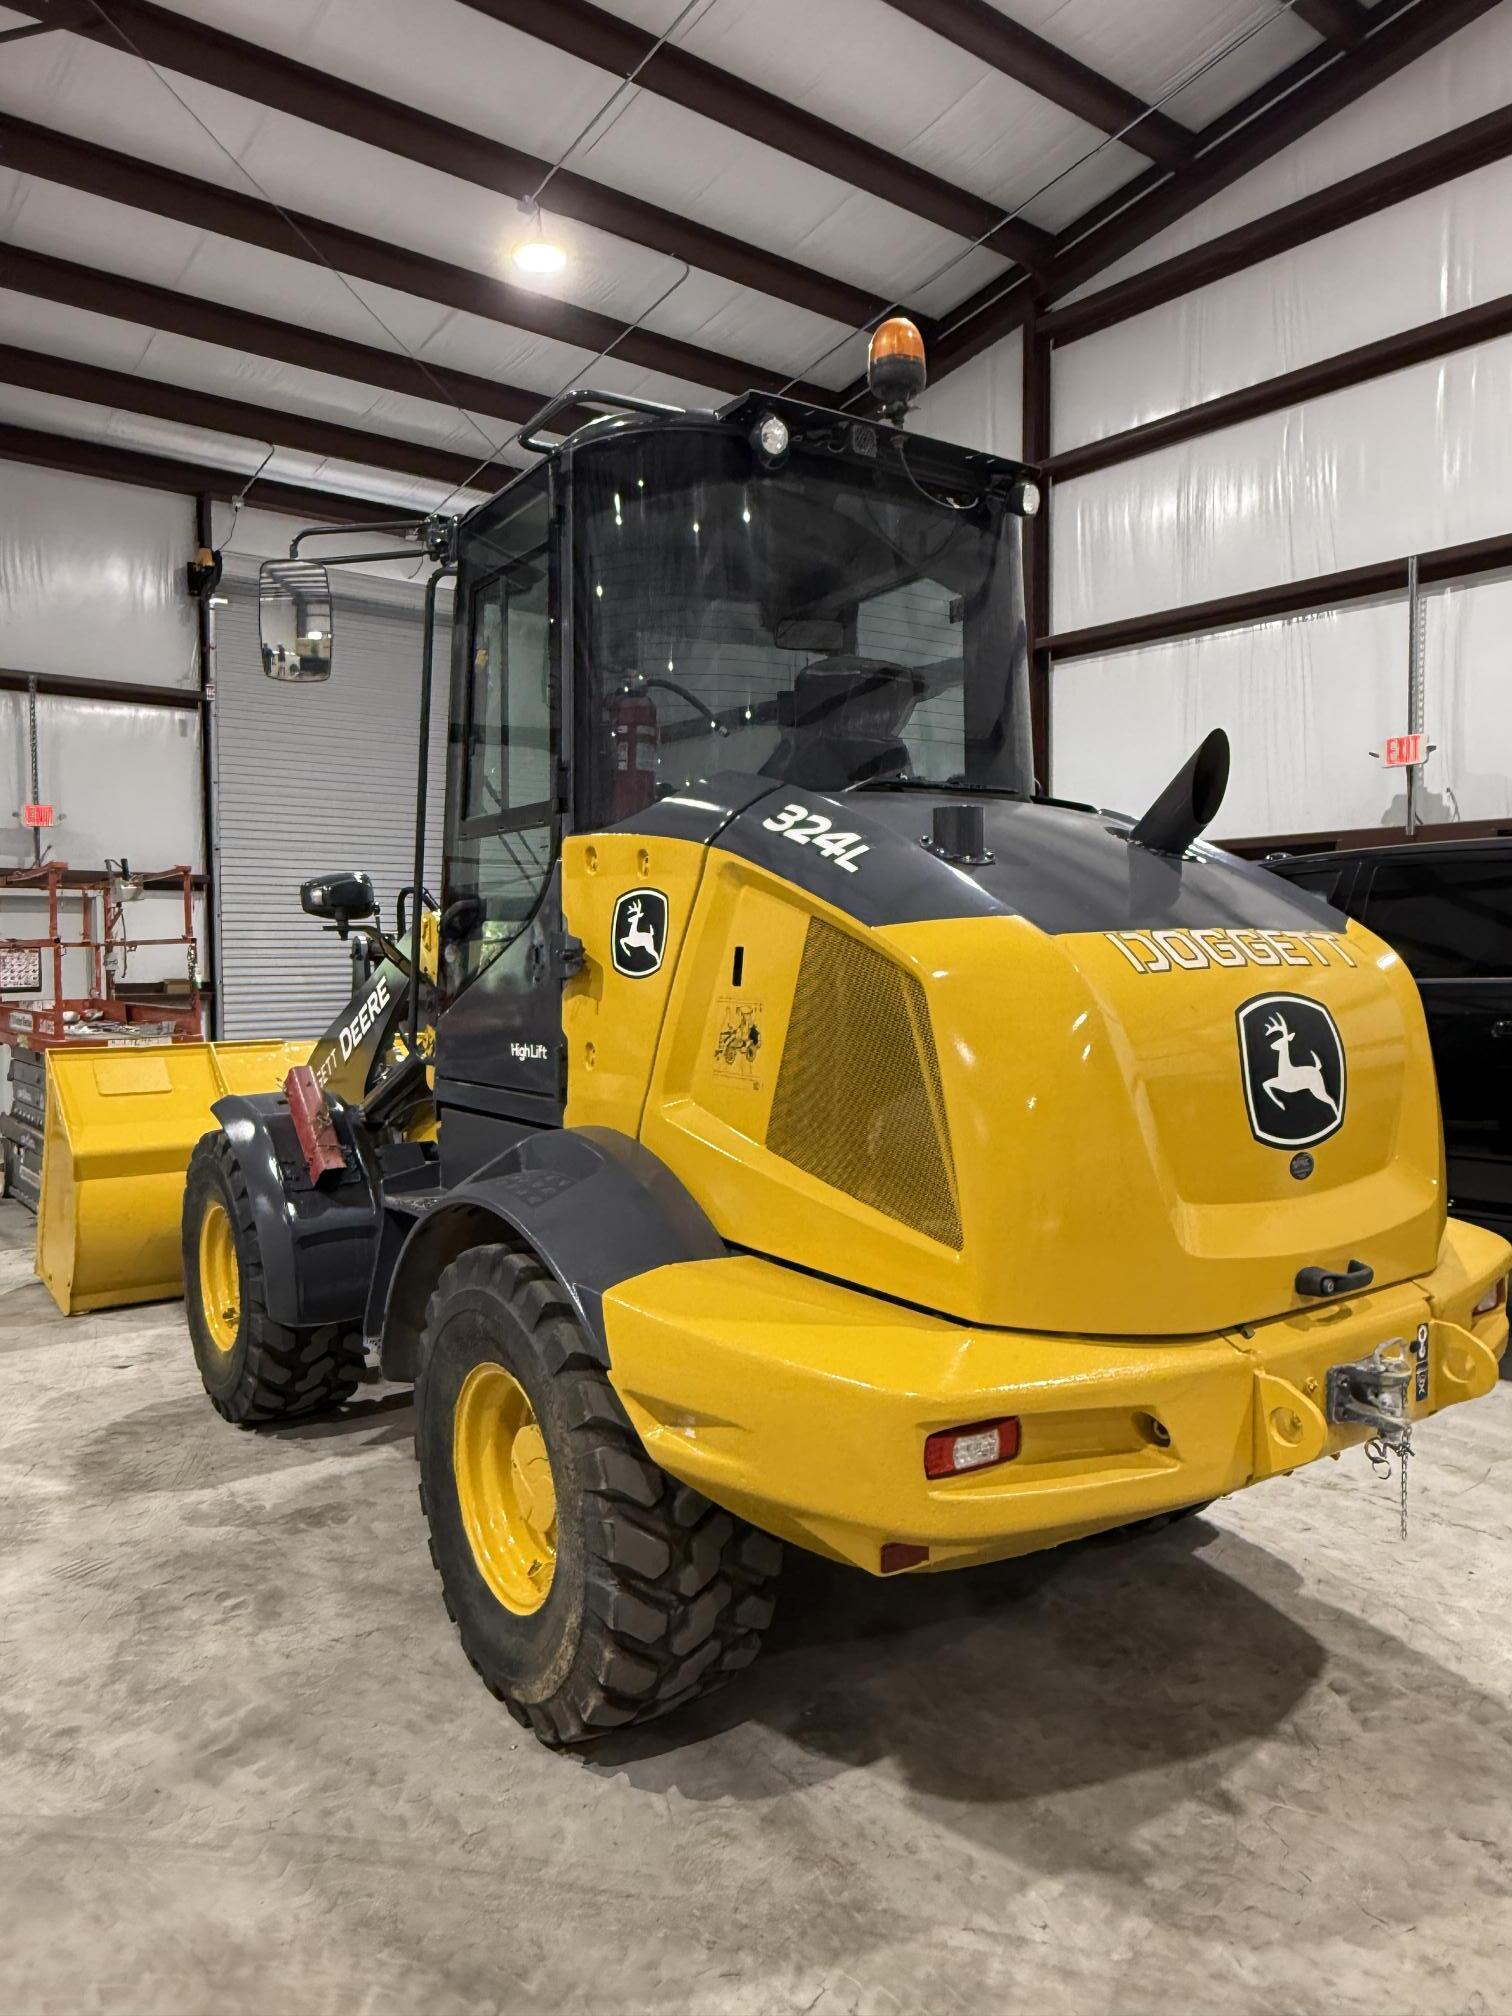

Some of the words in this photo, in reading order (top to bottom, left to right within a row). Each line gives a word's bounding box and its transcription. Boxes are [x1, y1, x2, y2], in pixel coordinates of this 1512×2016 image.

[762, 803, 871, 873] 324L
[1104, 928, 1358, 975] DOGGETT
[339, 975, 391, 1062] DEERE
